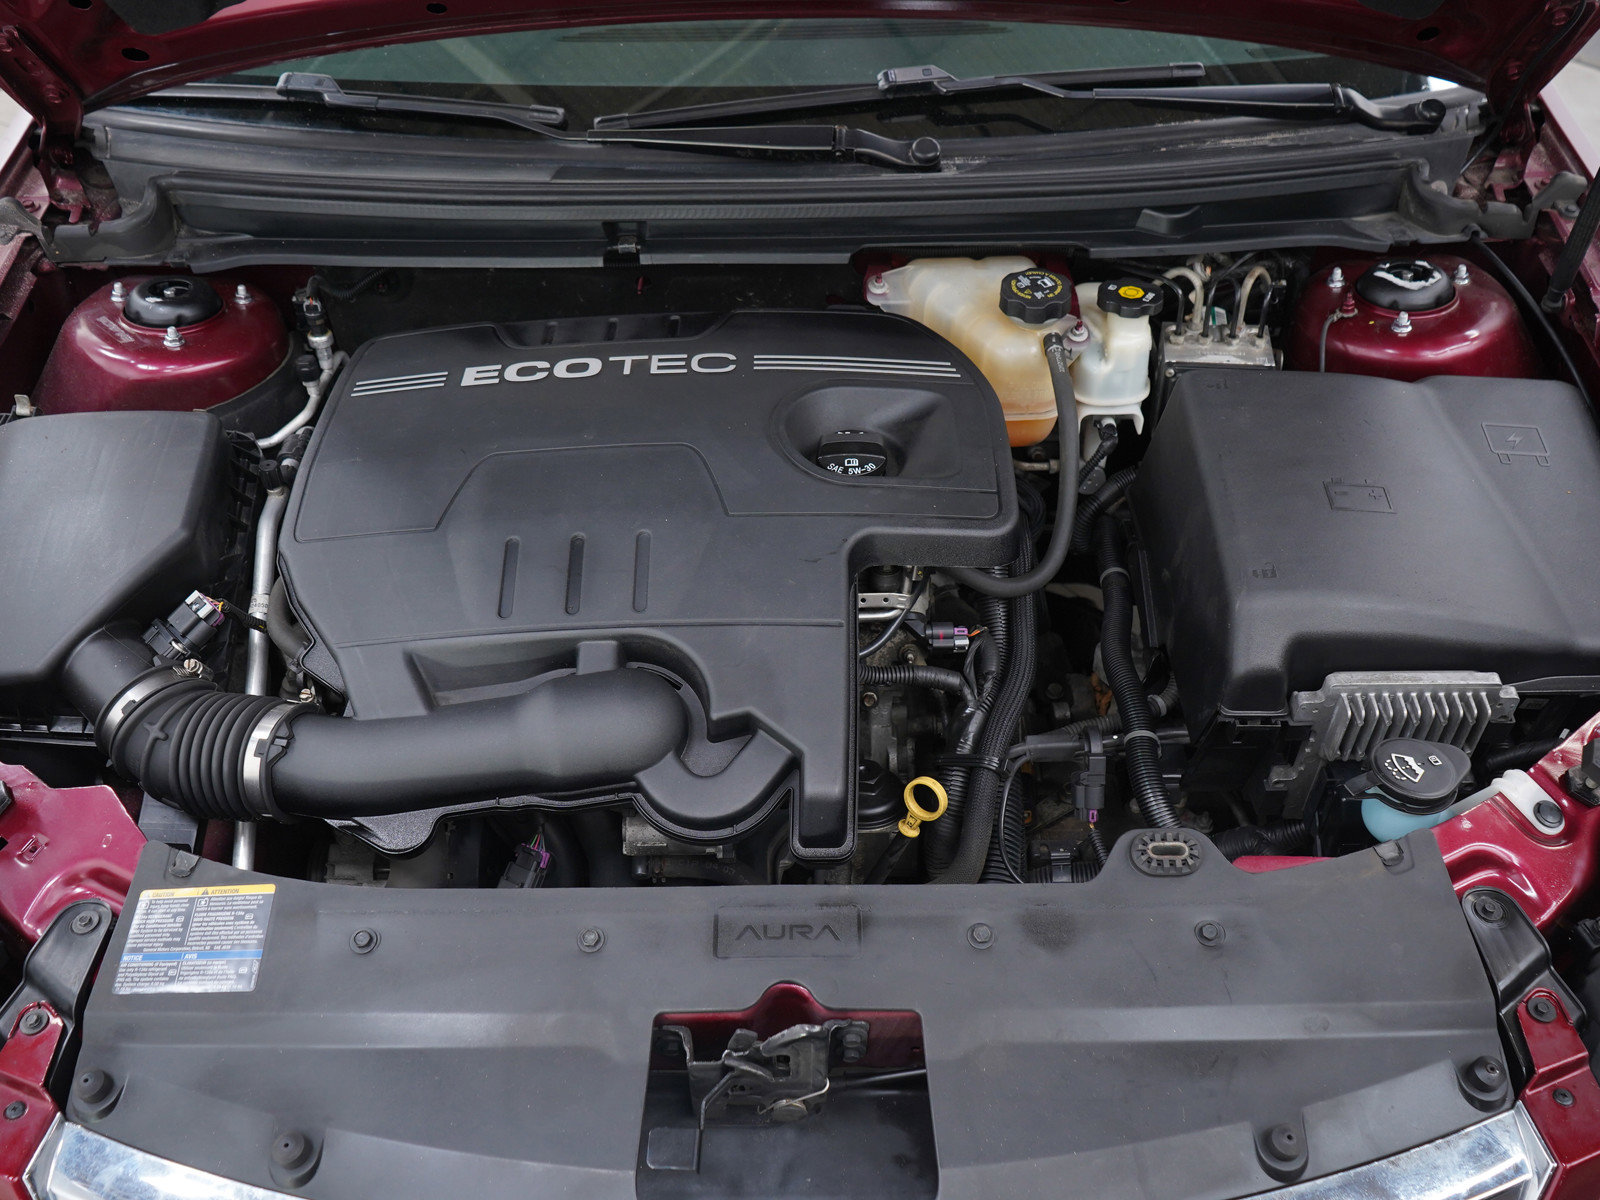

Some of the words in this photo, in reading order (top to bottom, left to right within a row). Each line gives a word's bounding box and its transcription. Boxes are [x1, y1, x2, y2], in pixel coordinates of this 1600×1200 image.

[460, 353, 737, 387] ECOTEC
[827, 462, 844, 474] SAE
[848, 462, 876, 475] 5W-30
[735, 923, 841, 942] AURA
